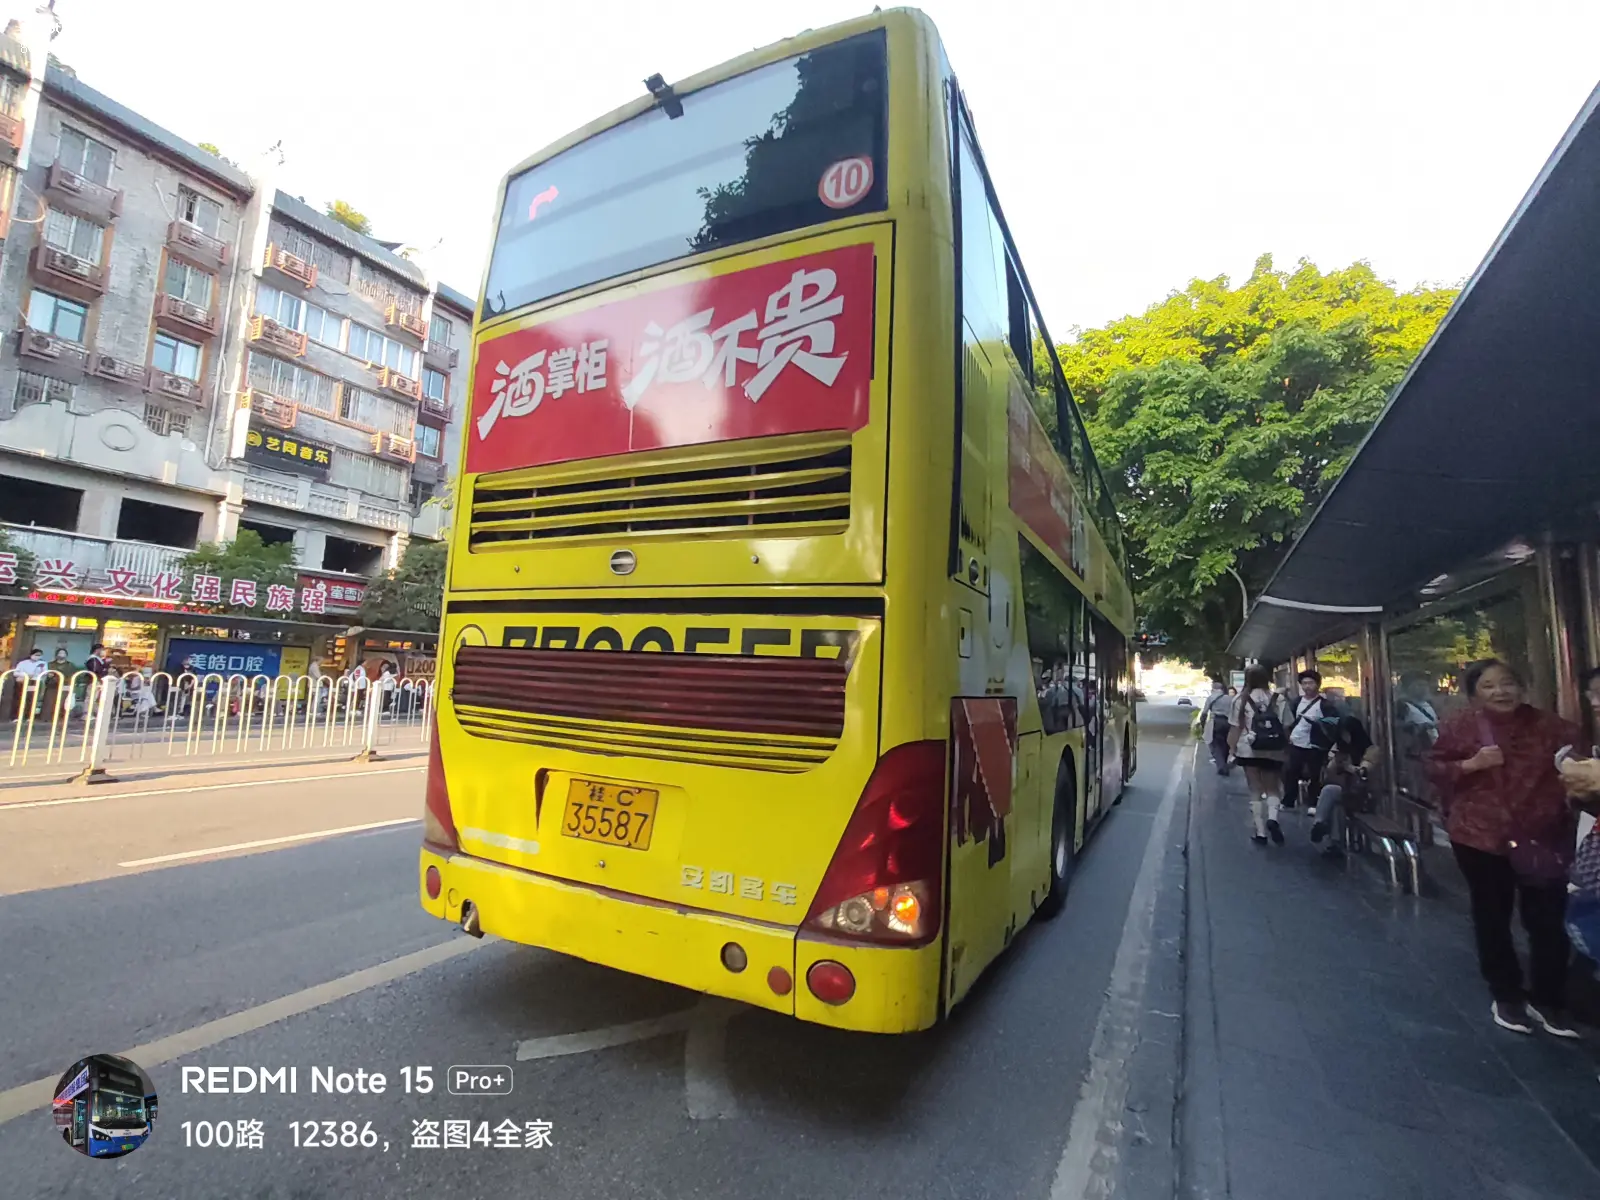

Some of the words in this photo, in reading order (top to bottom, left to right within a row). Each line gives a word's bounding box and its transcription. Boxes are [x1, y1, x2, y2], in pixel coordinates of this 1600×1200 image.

[829, 164, 863, 197] 10
[476, 338, 608, 441] 酒掌柜
[620, 267, 849, 412] 酒不贵
[101, 566, 326, 615] 文化强民族强
[188, 653, 264, 672] 美皓口腔
[567, 802, 649, 843] 35587
[680, 864, 797, 905] 安凯客车
